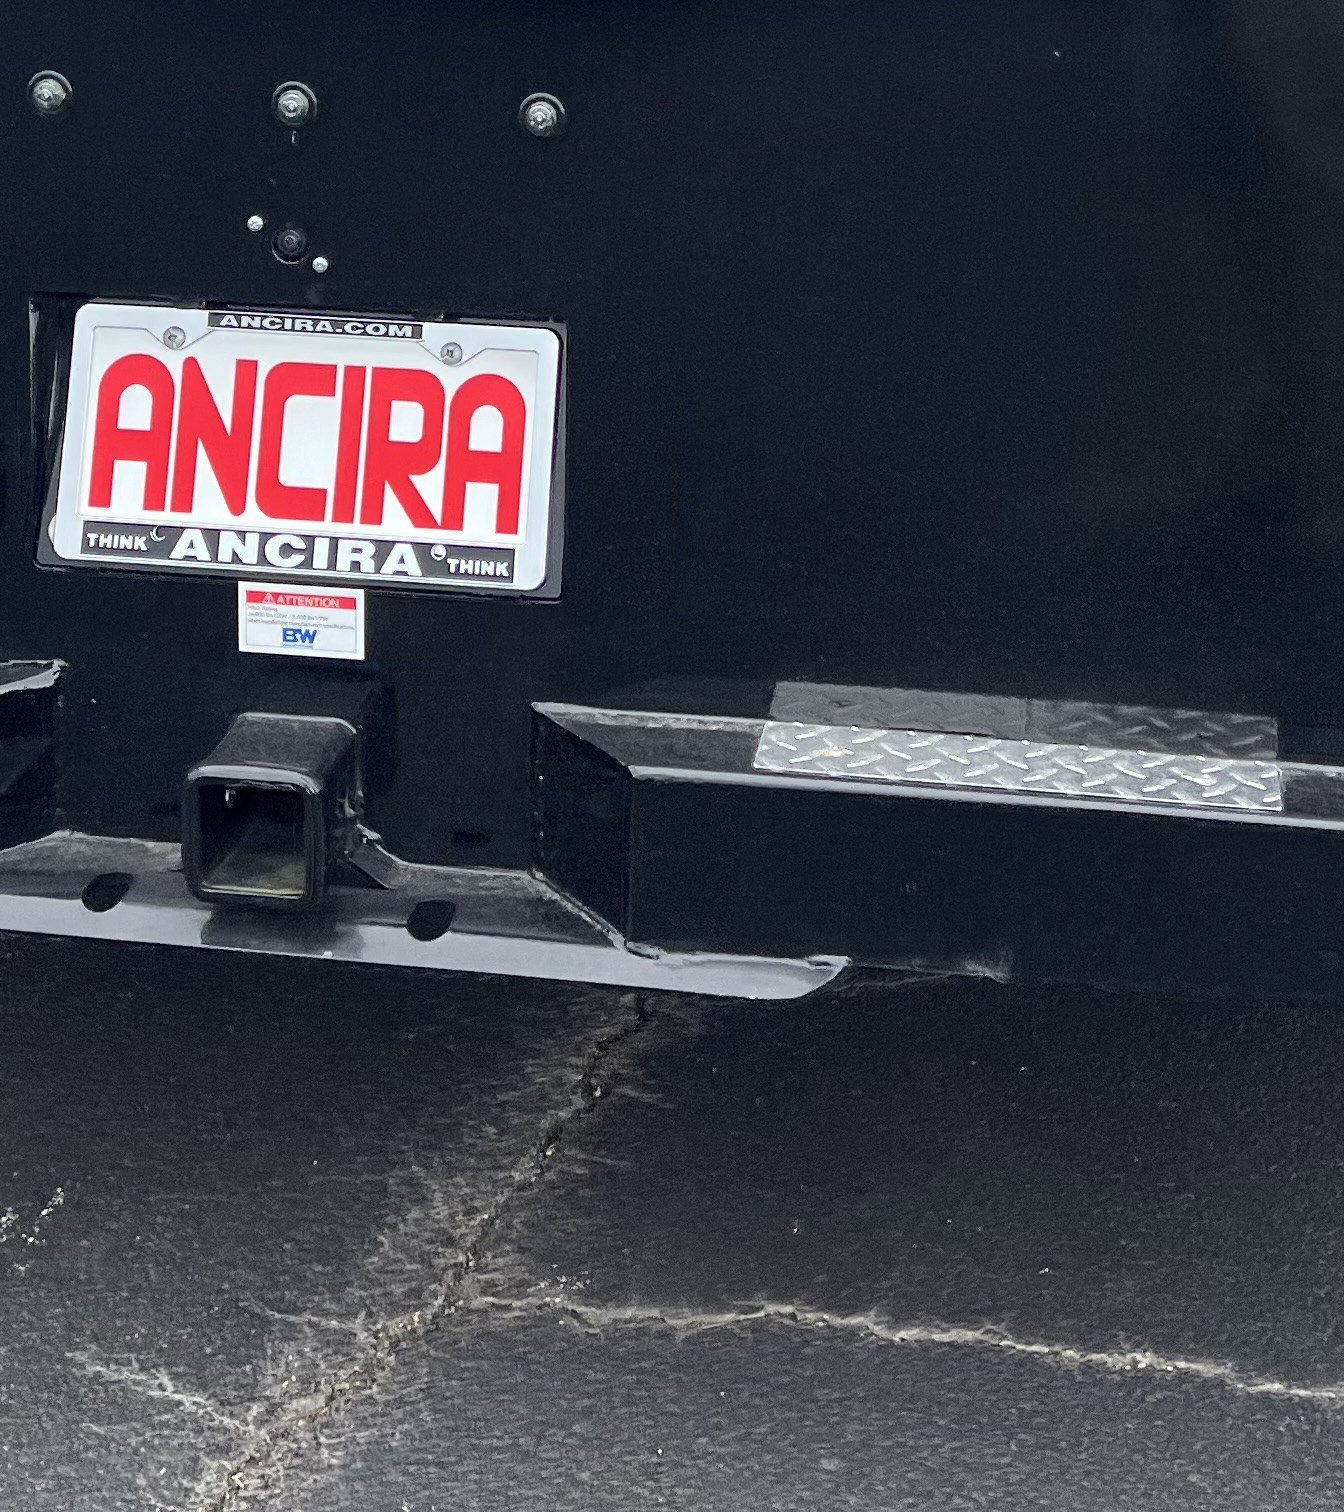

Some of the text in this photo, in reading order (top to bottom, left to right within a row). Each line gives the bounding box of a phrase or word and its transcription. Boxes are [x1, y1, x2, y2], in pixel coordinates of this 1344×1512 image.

[218, 314, 414, 339] ANCIRA.COM
[88, 353, 526, 535] ANCIRA
[86, 530, 511, 577] THINK ANCIRA THINK
[277, 595, 340, 609] ATTENTION
